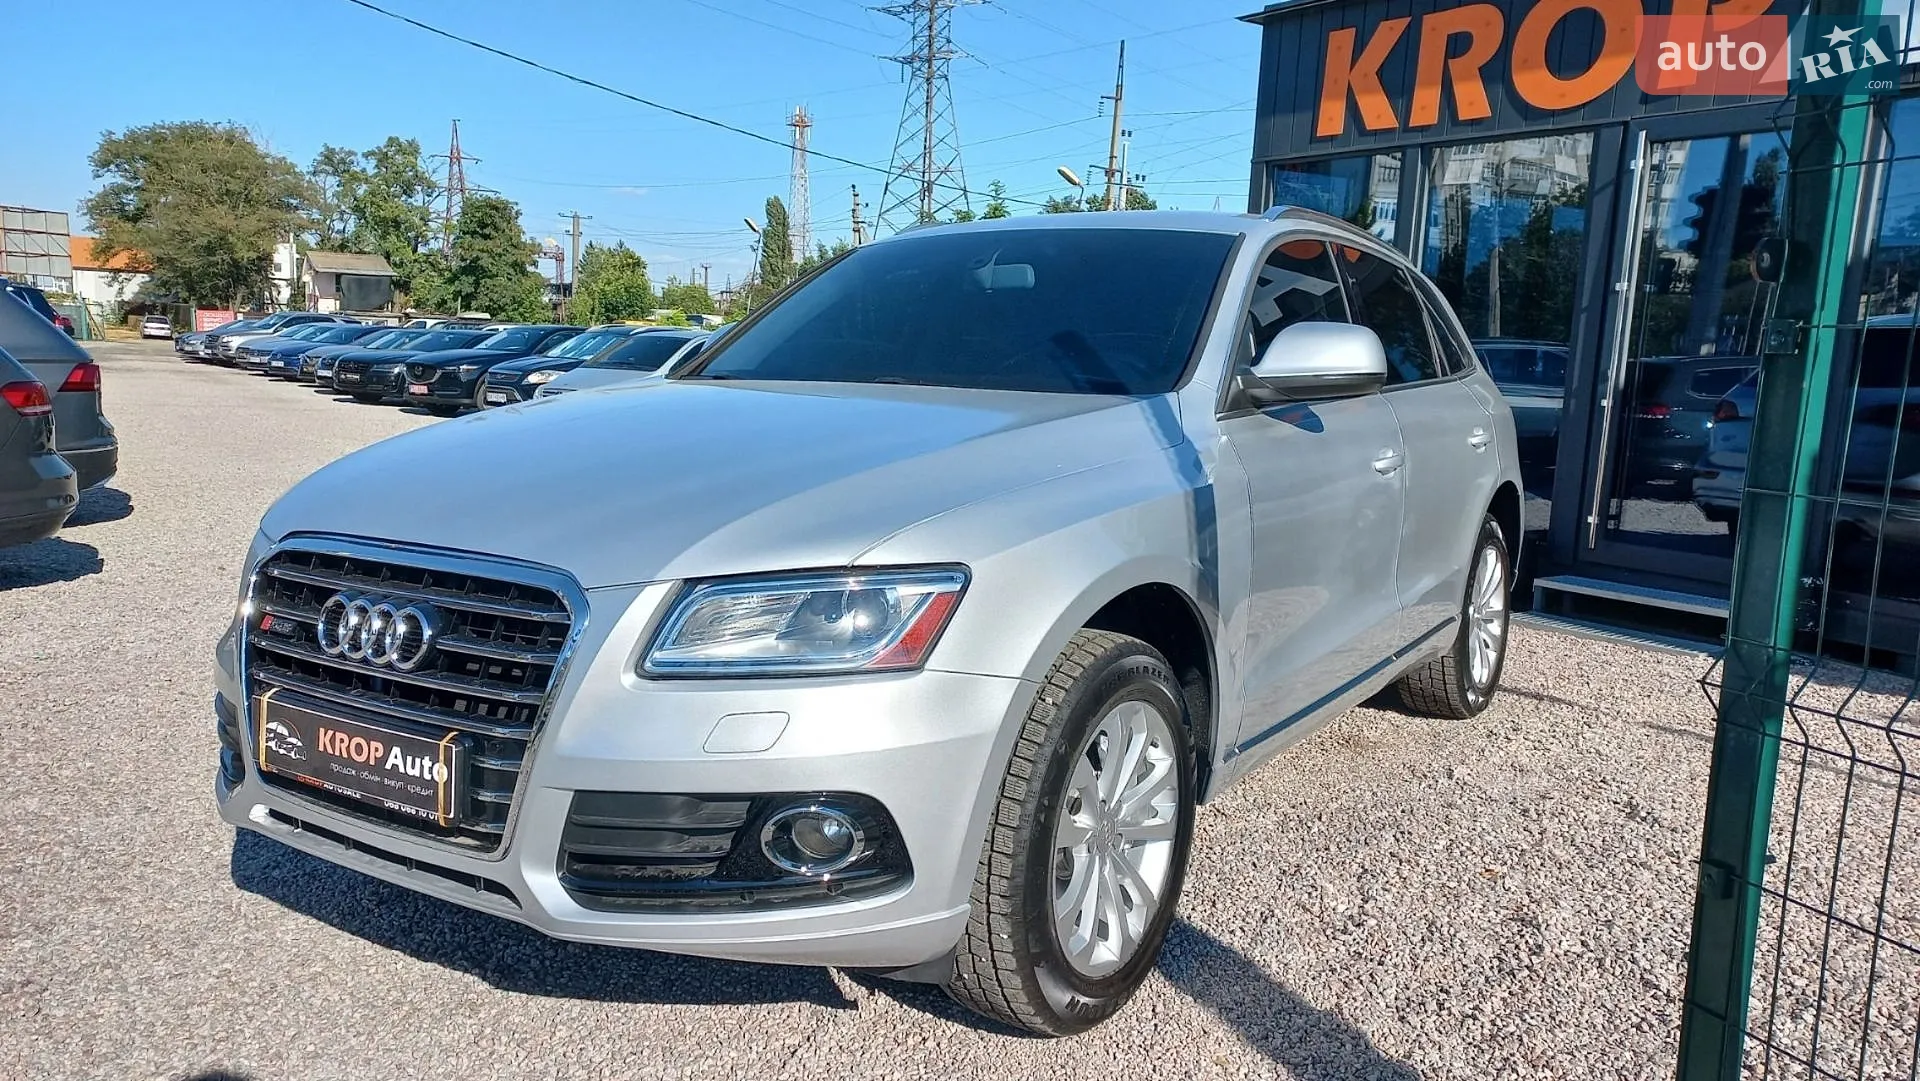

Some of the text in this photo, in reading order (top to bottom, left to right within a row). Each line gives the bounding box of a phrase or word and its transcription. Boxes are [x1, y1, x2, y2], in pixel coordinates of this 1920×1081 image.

[1316, 0, 1775, 138] KROP
[318, 727, 449, 783] KROP Auto
[330, 762, 357, 776] продаж
[384, 777, 404, 790] викуп
